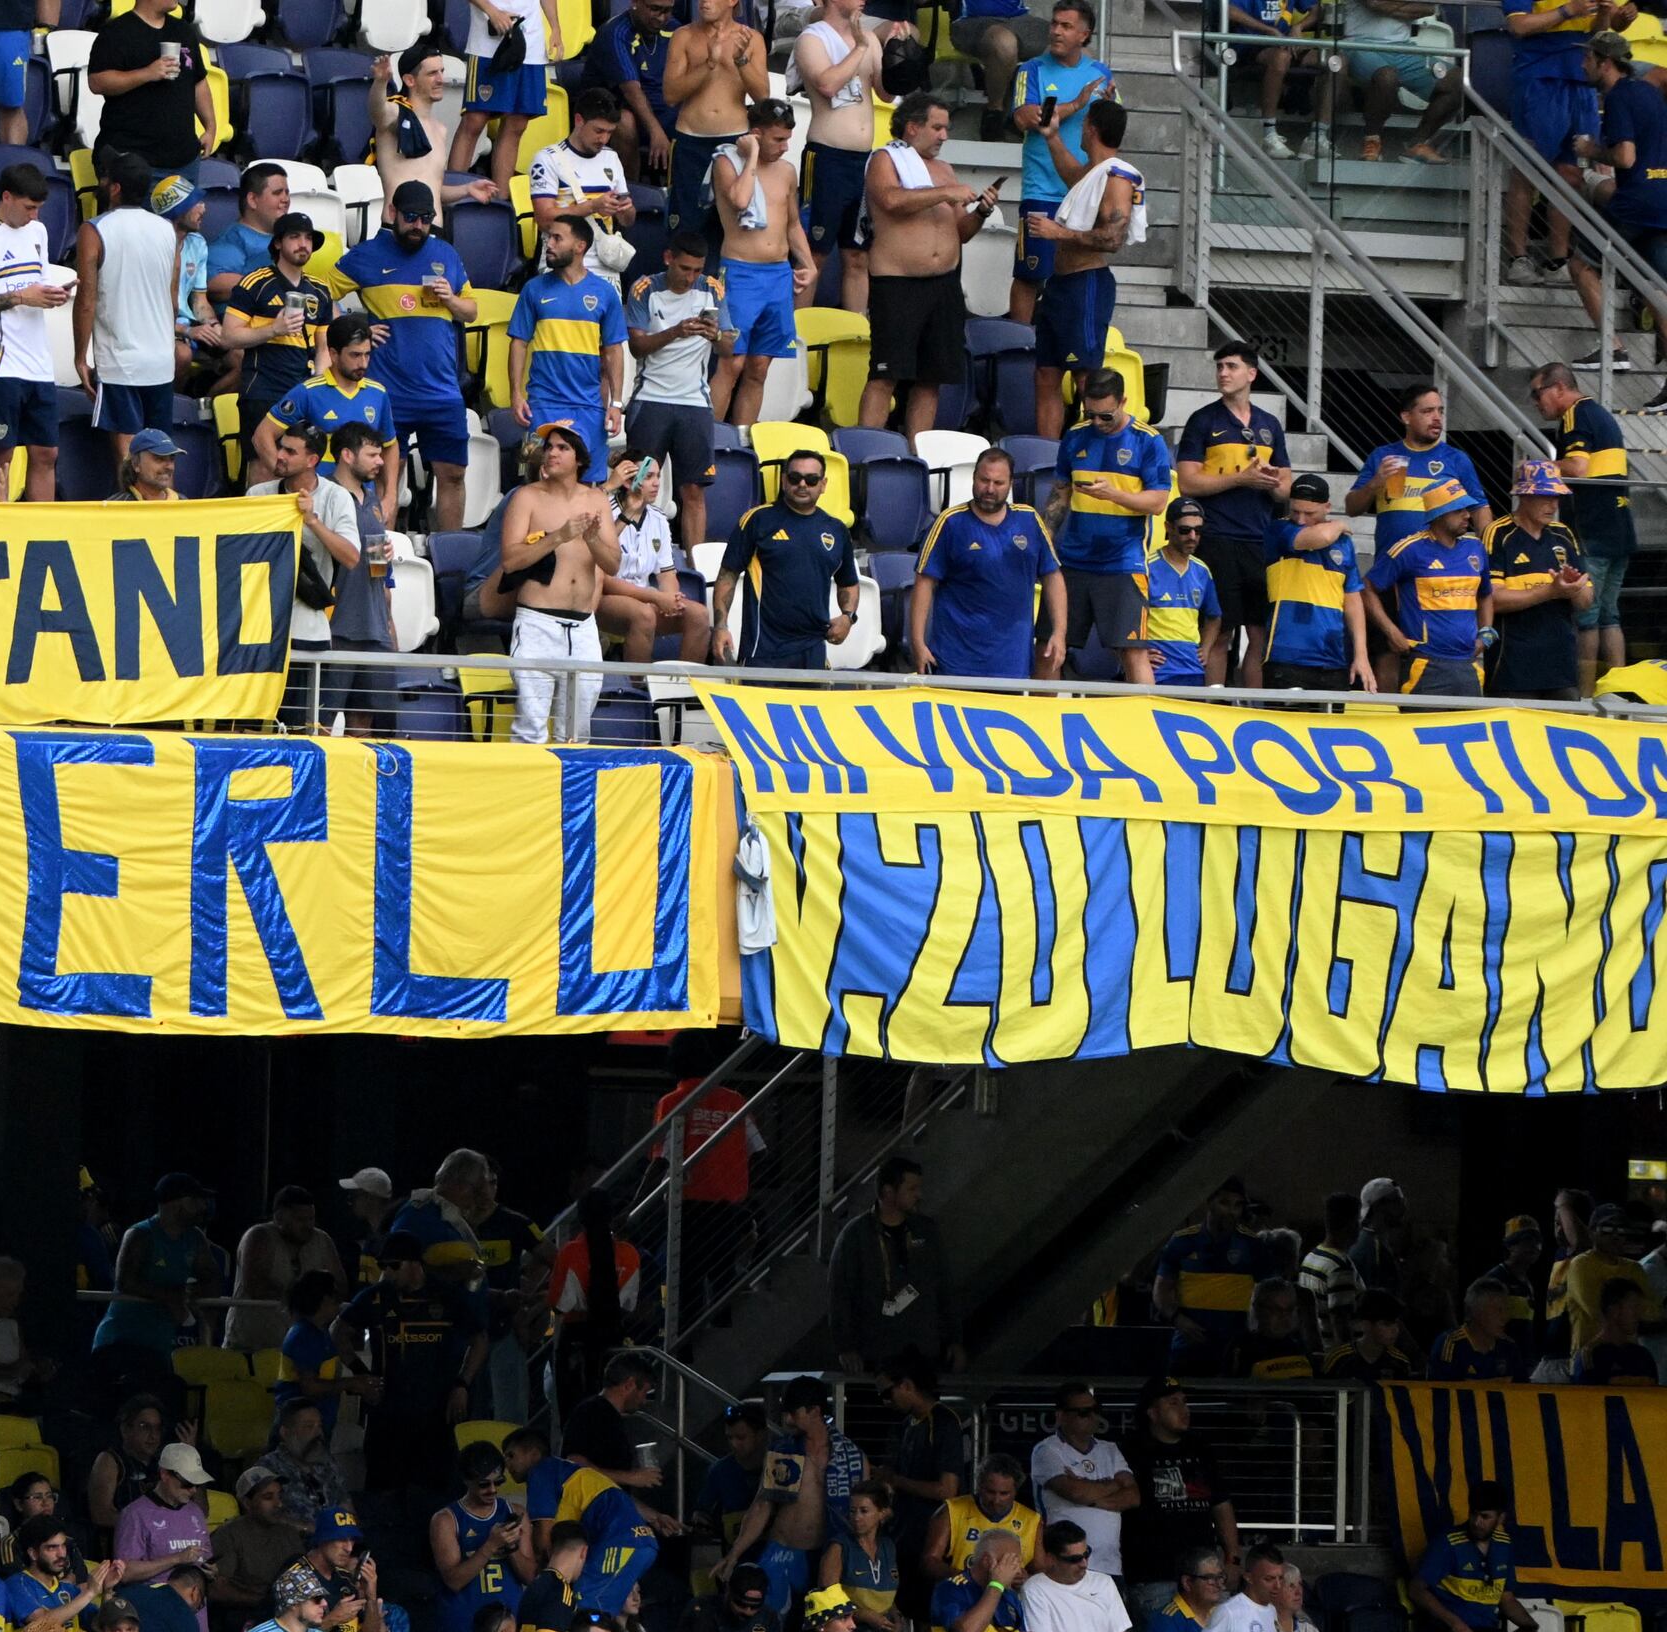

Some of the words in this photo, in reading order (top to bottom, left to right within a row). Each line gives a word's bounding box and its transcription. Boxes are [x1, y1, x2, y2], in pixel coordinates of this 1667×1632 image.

[709, 693, 868, 795] MI
[856, 700, 1165, 804] VIDA
[1151, 707, 1425, 816] POR
[1413, 720, 1553, 816] TI
[386, 1332, 443, 1345] betsson
[1379, 1384, 1663, 1592] VILLA
[479, 1563, 504, 1593] 12
